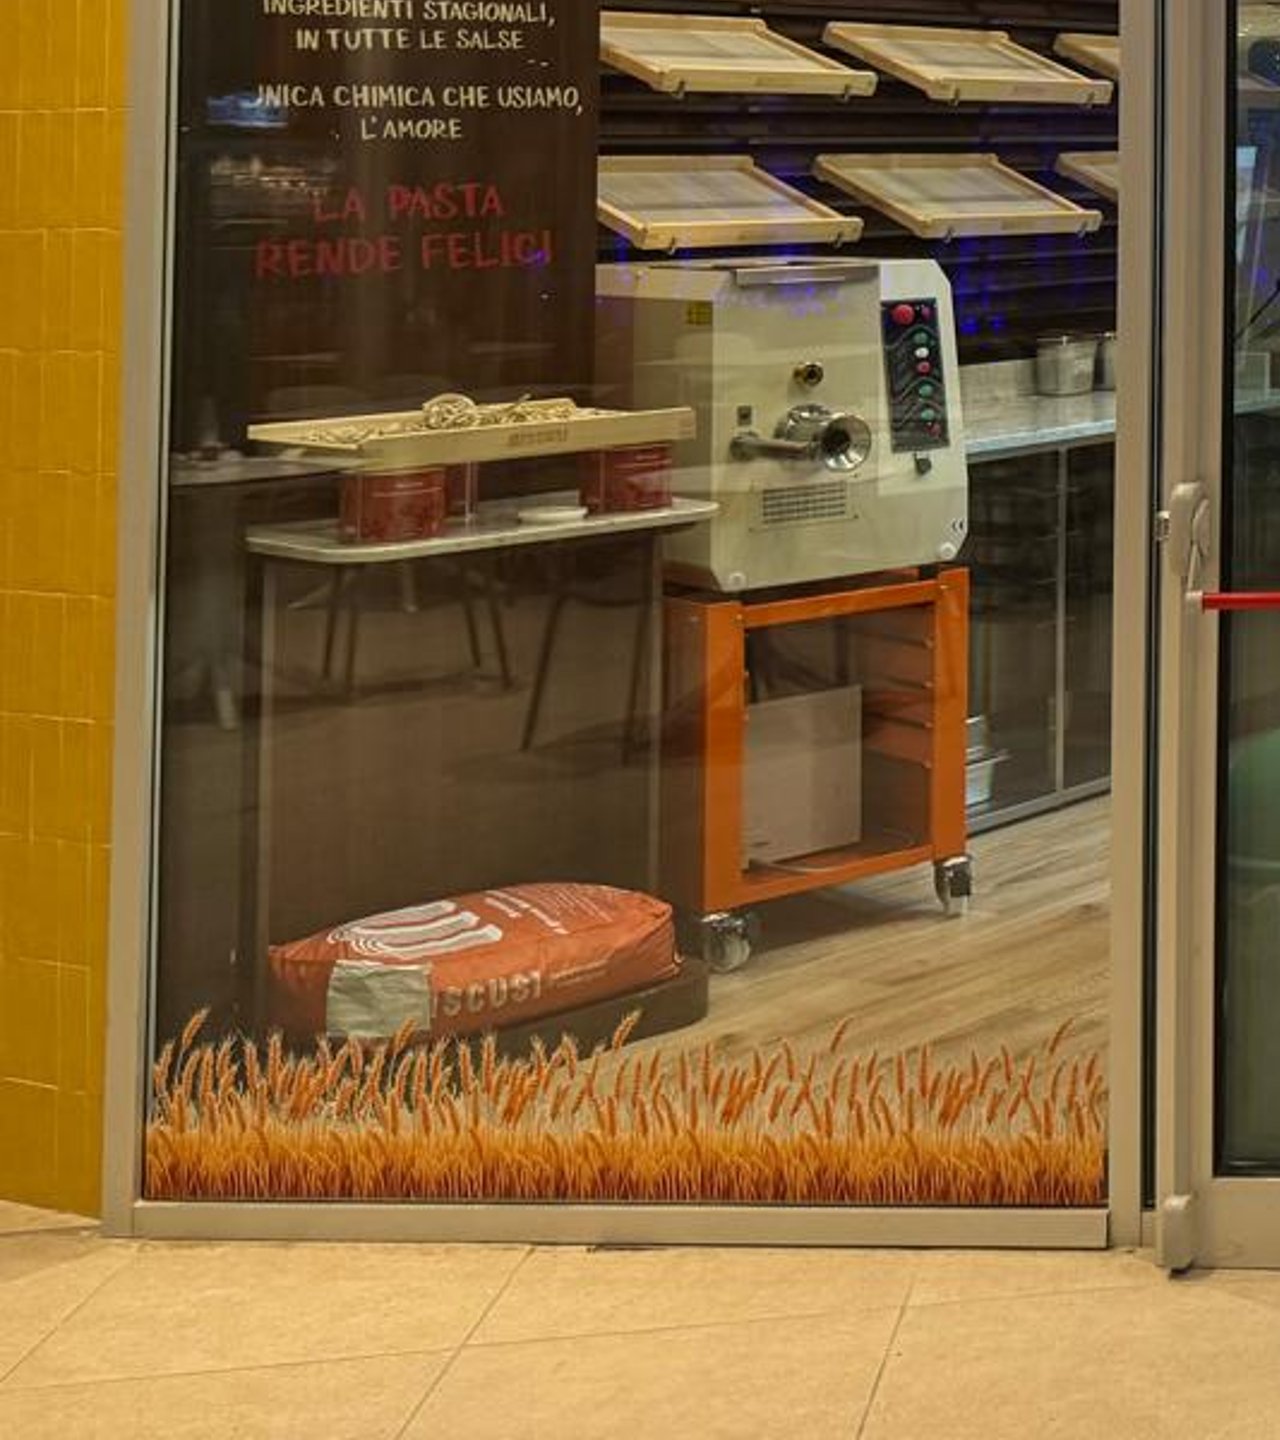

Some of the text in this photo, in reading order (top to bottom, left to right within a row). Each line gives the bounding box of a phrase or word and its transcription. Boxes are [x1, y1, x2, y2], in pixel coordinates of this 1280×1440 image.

[422, 0, 556, 27] STAGIONALI,
[296, 28, 526, 50] IN TUTTE LE SALSE
[332, 84, 436, 108] CHIMICA
[442, 85, 489, 107] CHE
[497, 85, 583, 115] USIAMO,
[360, 115, 464, 140] L'AMORE
[311, 179, 505, 224] LA PASTA
[254, 229, 553, 281] RENDE FELICI
